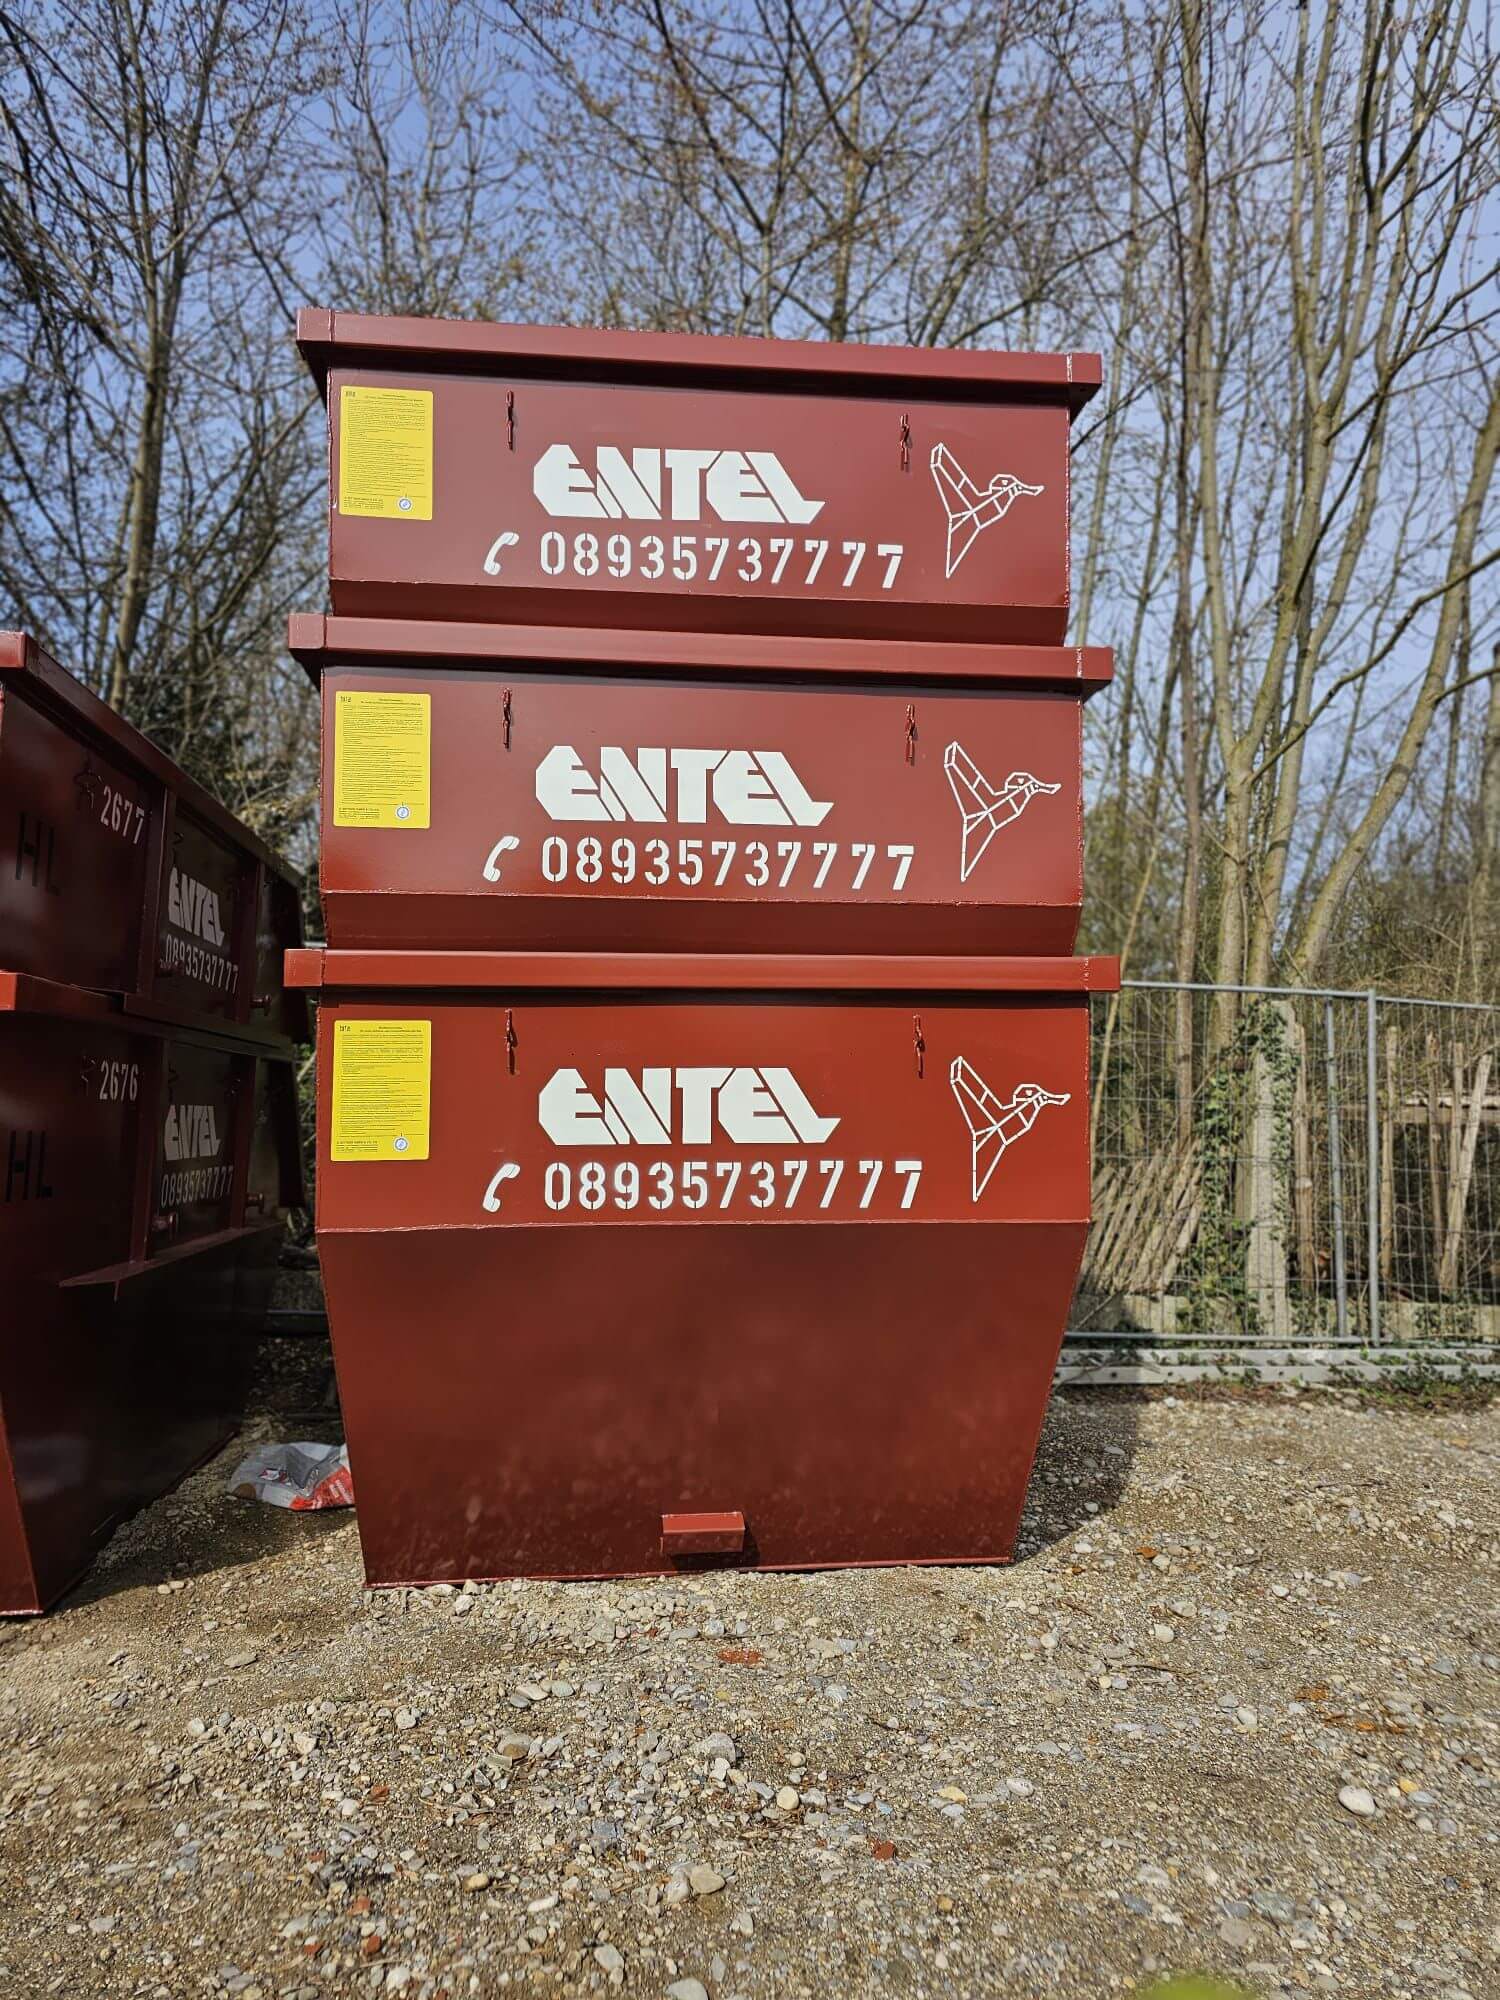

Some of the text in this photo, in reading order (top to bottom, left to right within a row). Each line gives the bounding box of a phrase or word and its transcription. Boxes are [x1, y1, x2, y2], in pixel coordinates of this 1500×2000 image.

[533, 444, 825, 524] ENTEL
[540, 531, 903, 588] 08935737777
[535, 745, 834, 826] ENTEL
[101, 785, 145, 844] 2677
[542, 836, 914, 890] 08935737777
[168, 866, 225, 947] ENTEL
[99, 1060, 139, 1102] 2676
[538, 1068, 841, 1145] ENTEL
[164, 1105, 220, 1160] ENTEL
[161, 1166, 234, 1208] 08935737777
[544, 1160, 922, 1210] 08935737777
